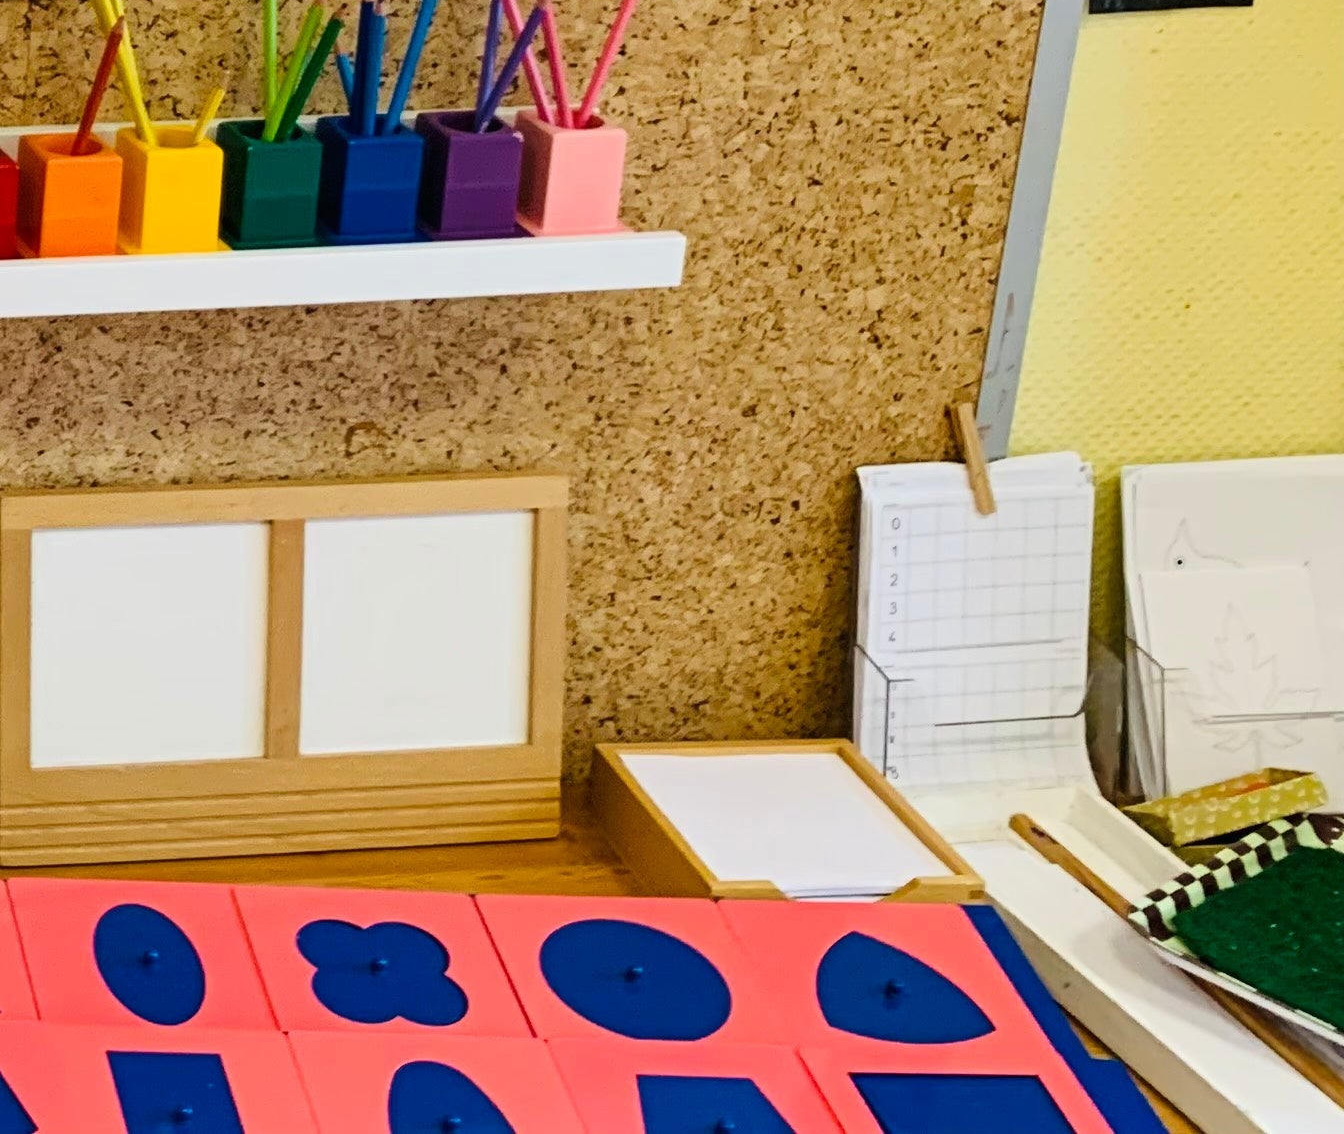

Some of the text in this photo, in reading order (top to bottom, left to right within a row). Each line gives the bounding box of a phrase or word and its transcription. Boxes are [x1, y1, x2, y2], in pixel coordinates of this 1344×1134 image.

[890, 517, 901, 531] 0
[891, 544, 899, 558] 1
[889, 573, 899, 587] 2
[888, 601, 898, 616] 3
[887, 629, 897, 643] 4
